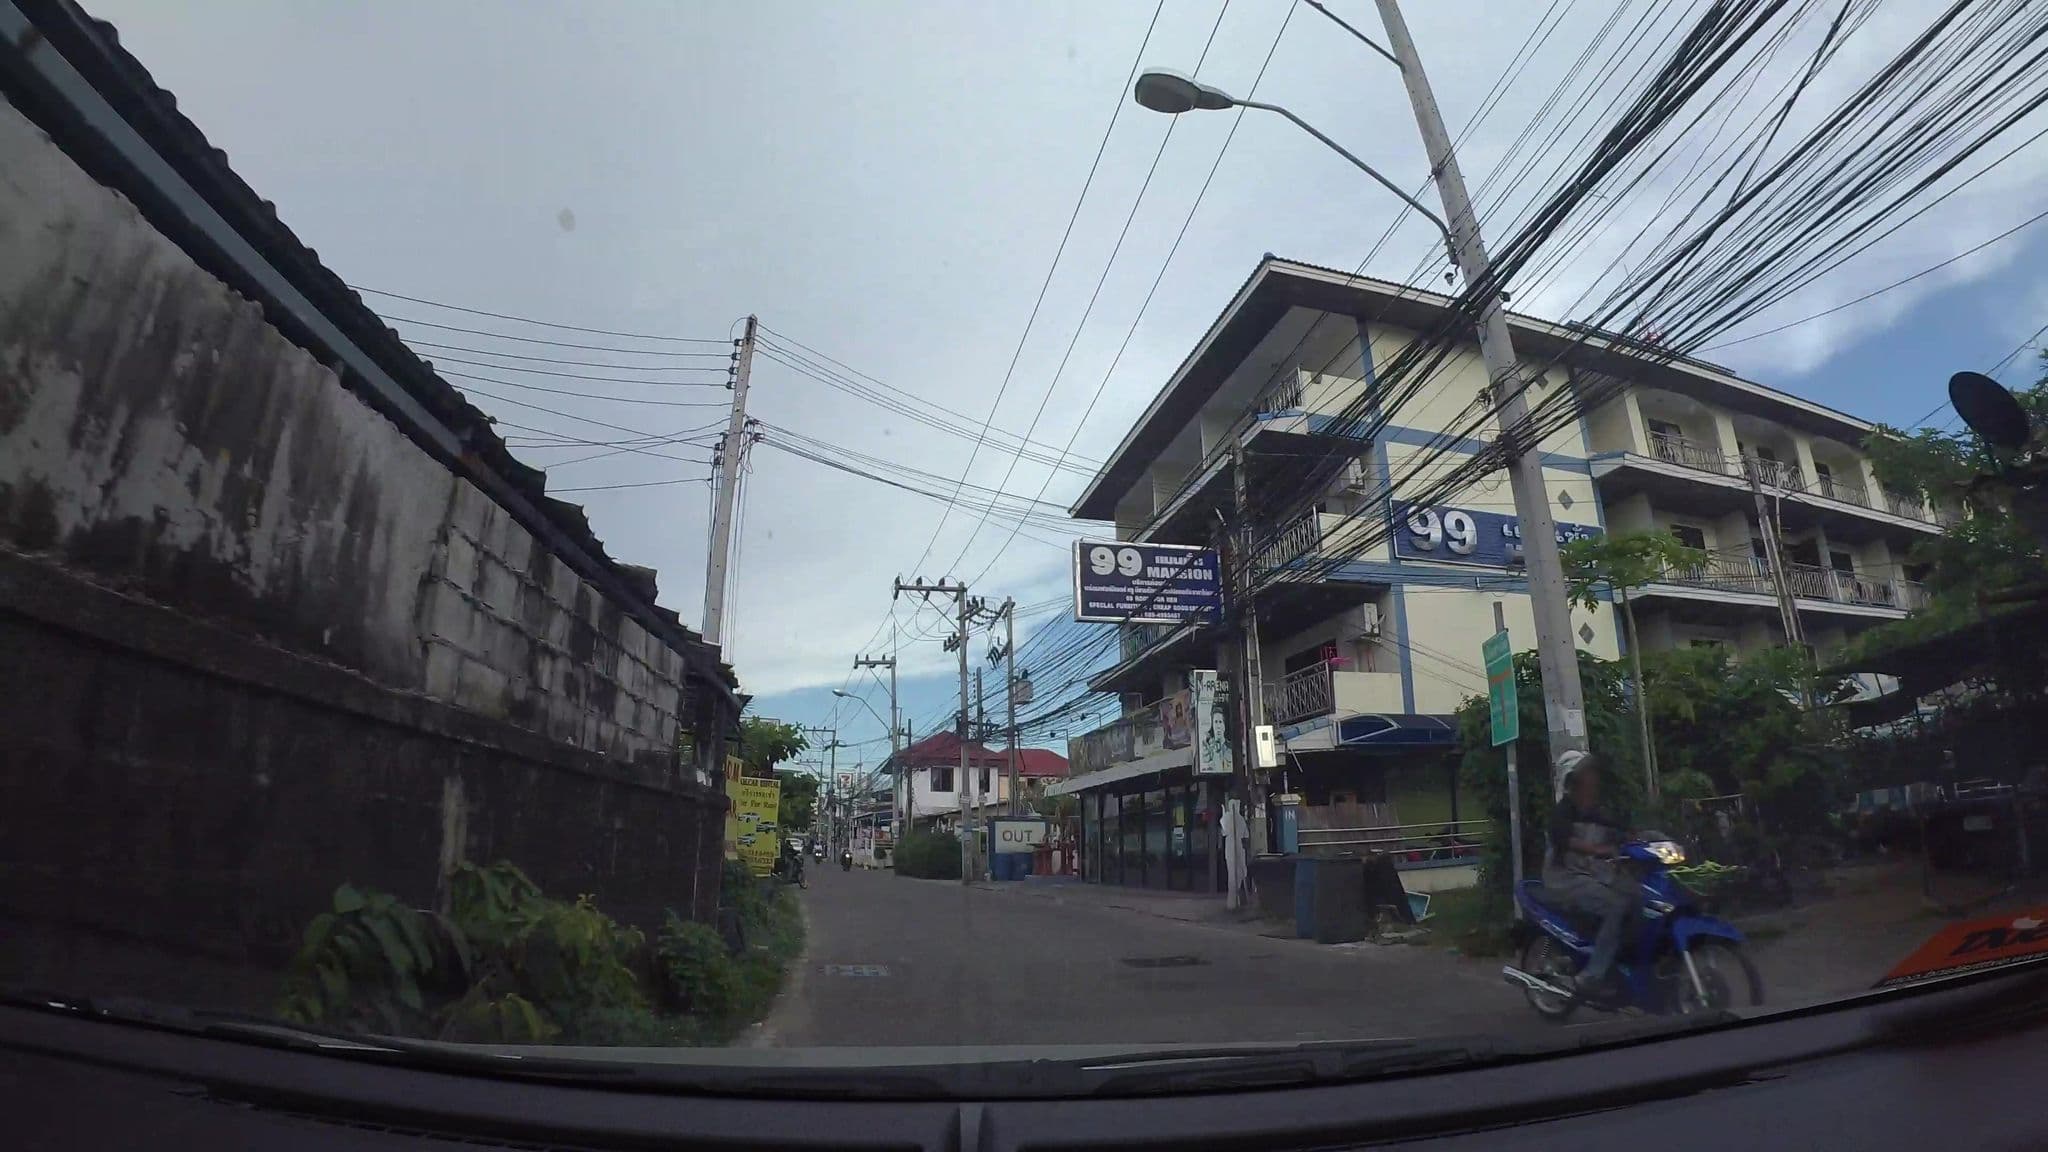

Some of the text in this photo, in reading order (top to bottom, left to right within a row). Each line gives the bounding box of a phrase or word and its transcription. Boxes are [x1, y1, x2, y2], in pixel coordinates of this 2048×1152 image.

[1407, 505, 1478, 555] 99
[1090, 546, 1143, 577] 99
[1147, 567, 1213, 581] MANSION
[1284, 809, 1296, 820] IN
[1002, 830, 1033, 842] OUT
